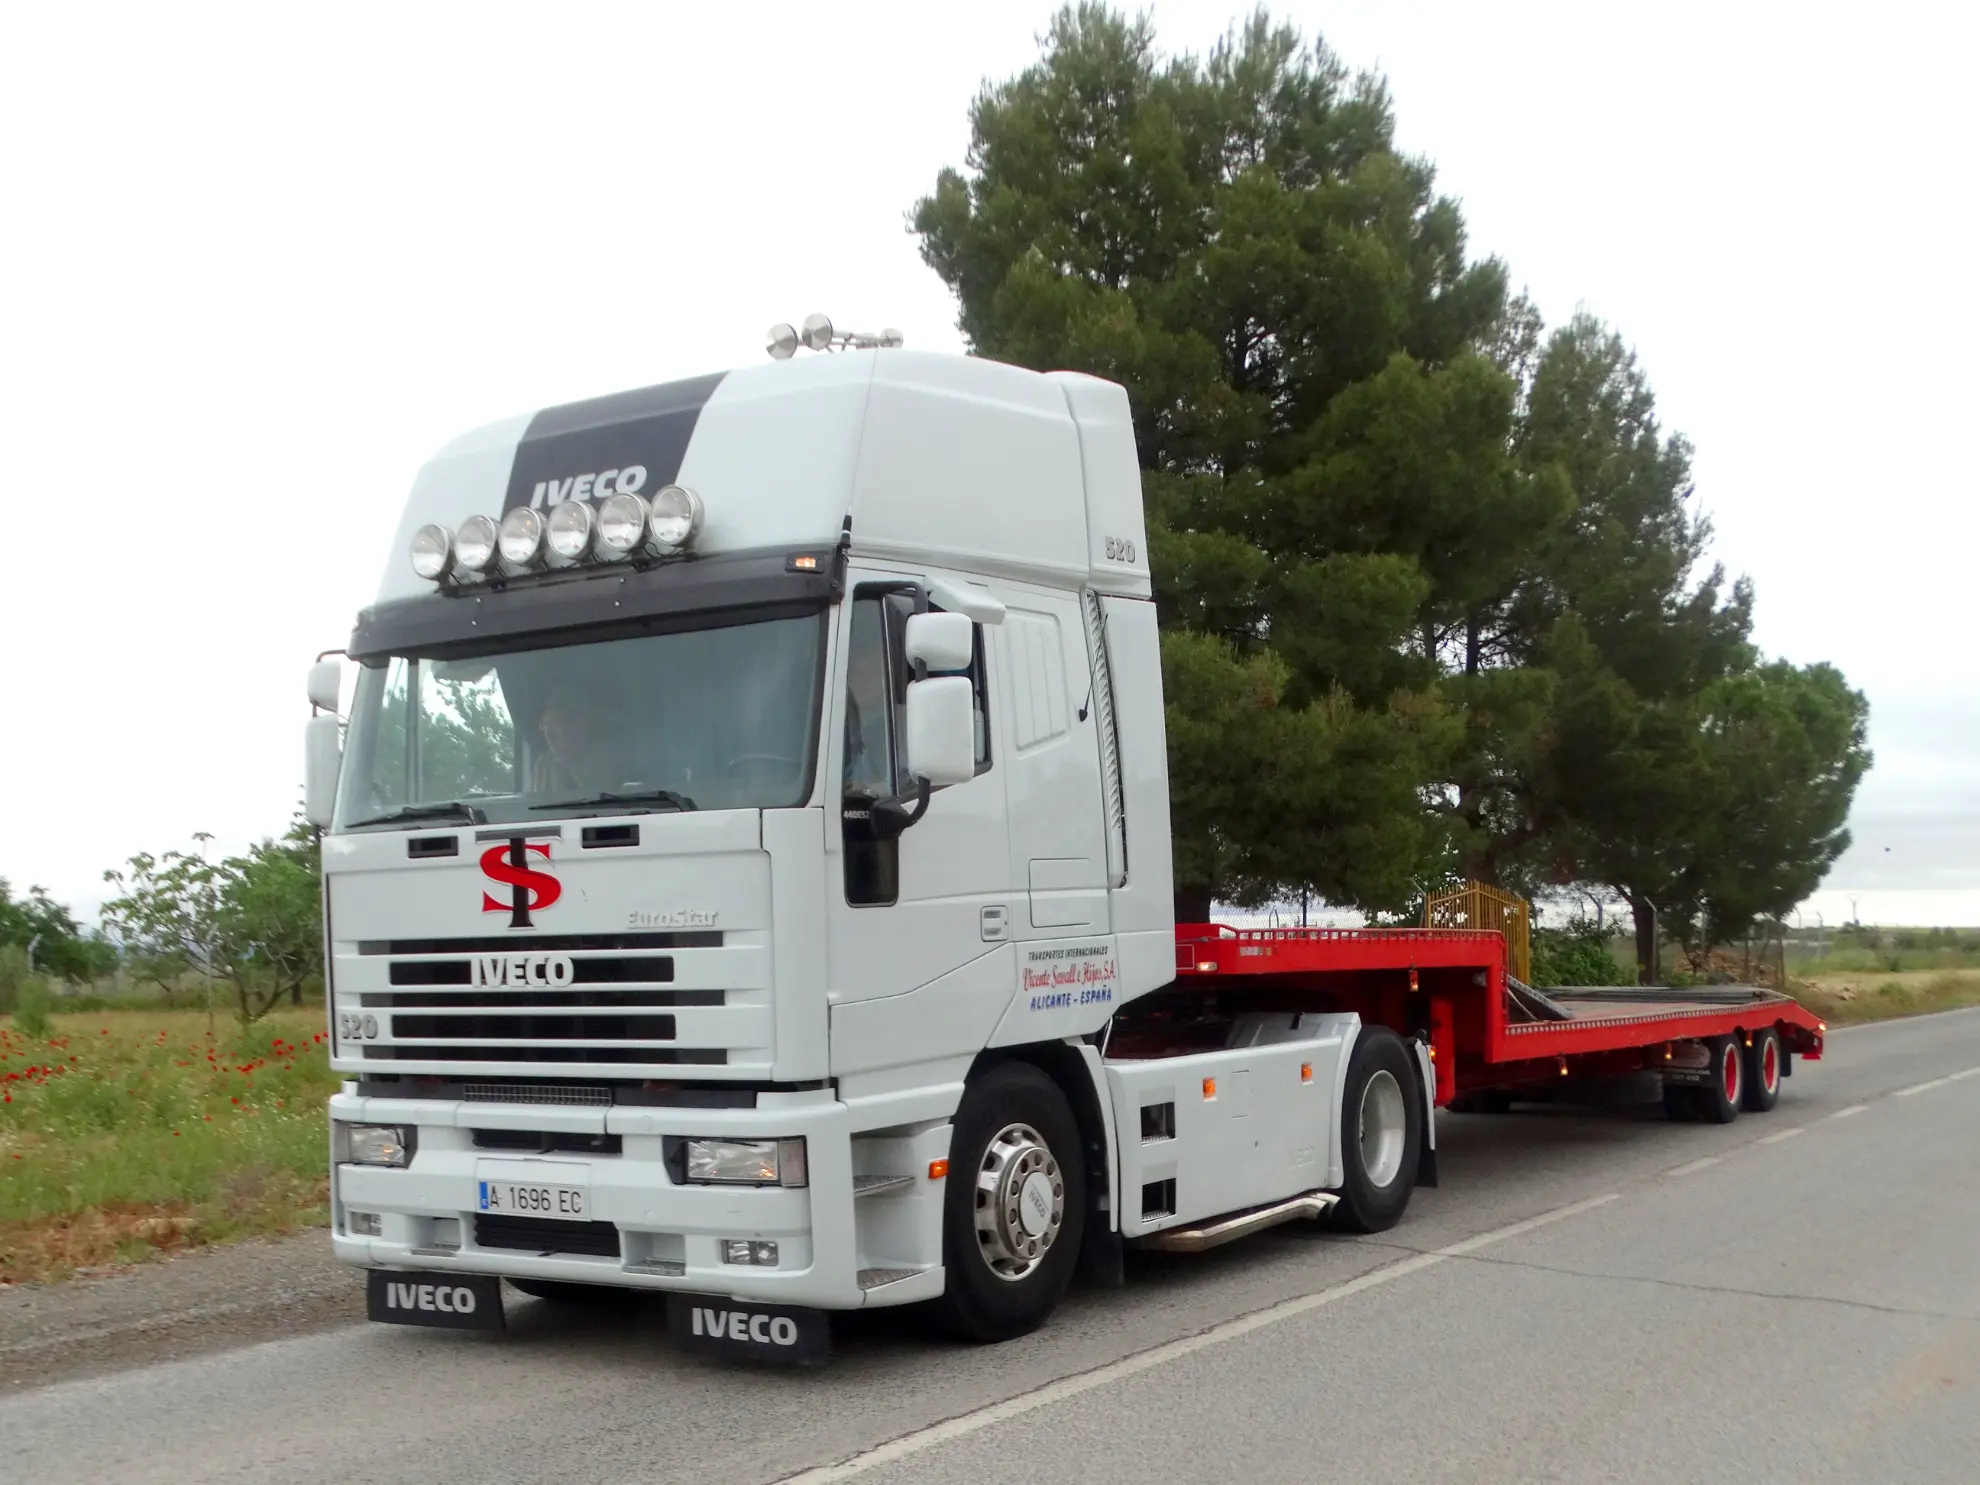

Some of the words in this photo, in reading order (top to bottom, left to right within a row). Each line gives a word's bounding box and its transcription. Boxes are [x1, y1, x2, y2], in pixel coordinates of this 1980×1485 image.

[530, 465, 648, 509] IVECO
[1105, 535, 1136, 563] 520
[627, 908, 718, 929] EuroStar
[1028, 949, 1064, 960] TRANSPORTES
[1065, 946, 1108, 958] INTERNACIONALES
[470, 955, 574, 987] IVECO
[1030, 993, 1071, 1011] ALICANTE
[1080, 984, 1112, 1005] ESPAÑA
[340, 1014, 378, 1039] 520
[490, 1186, 499, 1207] A
[509, 1187, 551, 1211] 1696
[559, 1190, 582, 1213] EC
[387, 1283, 476, 1314] IVECO
[691, 1307, 798, 1346] IVECO
